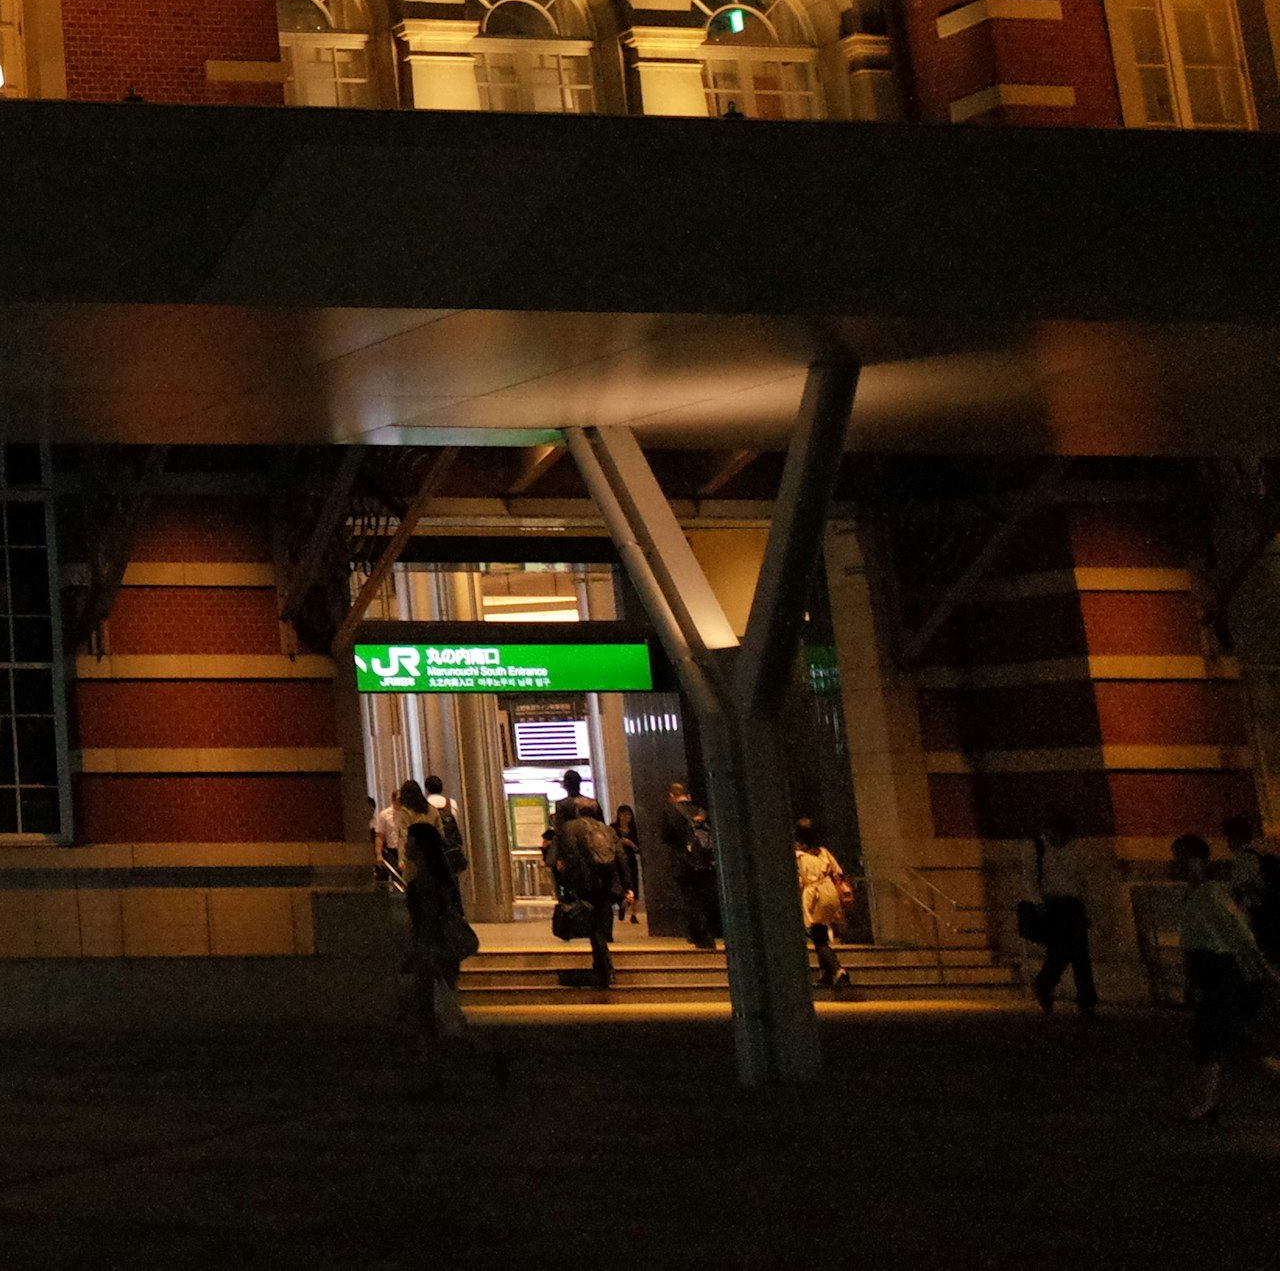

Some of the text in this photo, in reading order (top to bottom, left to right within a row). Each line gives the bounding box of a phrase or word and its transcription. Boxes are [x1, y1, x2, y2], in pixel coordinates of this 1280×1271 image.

[371, 647, 421, 677] JR
[426, 666, 548, 677] Marunouchi South Entrance
